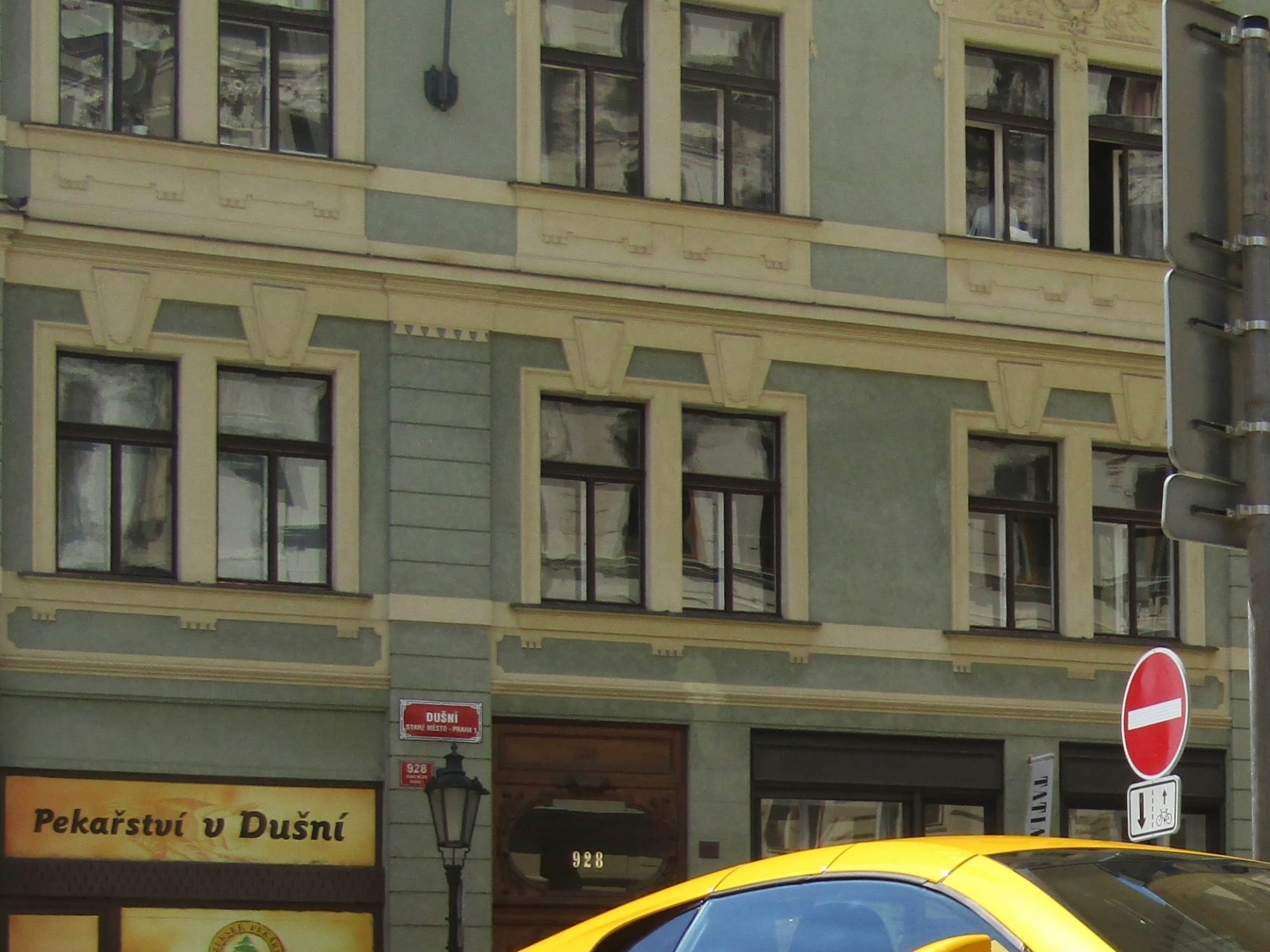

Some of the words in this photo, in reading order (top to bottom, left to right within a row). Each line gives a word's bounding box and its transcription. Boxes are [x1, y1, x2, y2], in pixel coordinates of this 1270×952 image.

[426, 710, 459, 723] DUŠNÍ
[427, 724, 447, 732] MĚSTO
[407, 763, 428, 774] 928
[34, 808, 187, 837] Pekařství
[203, 815, 226, 838] v
[239, 811, 349, 842] Dušní
[572, 850, 604, 868] 928
